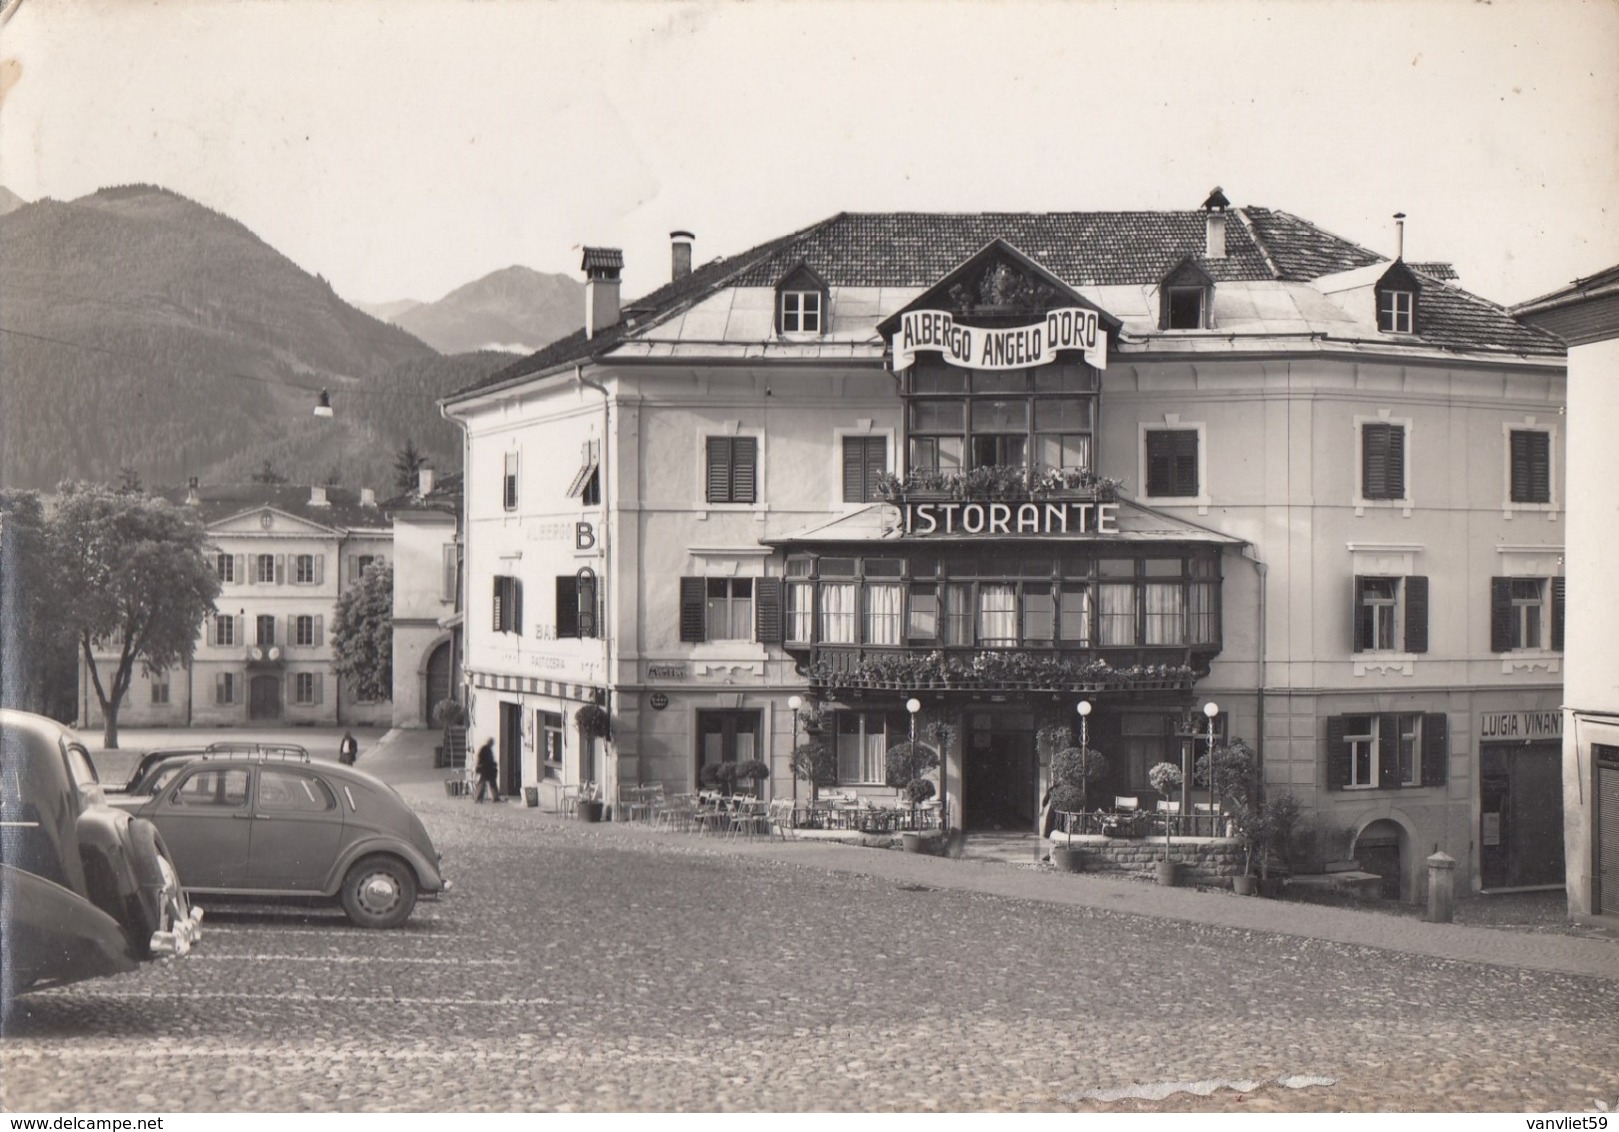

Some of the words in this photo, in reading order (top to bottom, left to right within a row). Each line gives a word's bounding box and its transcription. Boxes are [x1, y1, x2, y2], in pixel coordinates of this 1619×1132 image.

[903, 312, 971, 362] ALBERGO
[982, 328, 1041, 366] ANGELO
[1048, 311, 1097, 349] D'ORO
[1481, 715, 1518, 737] LUIGIA
